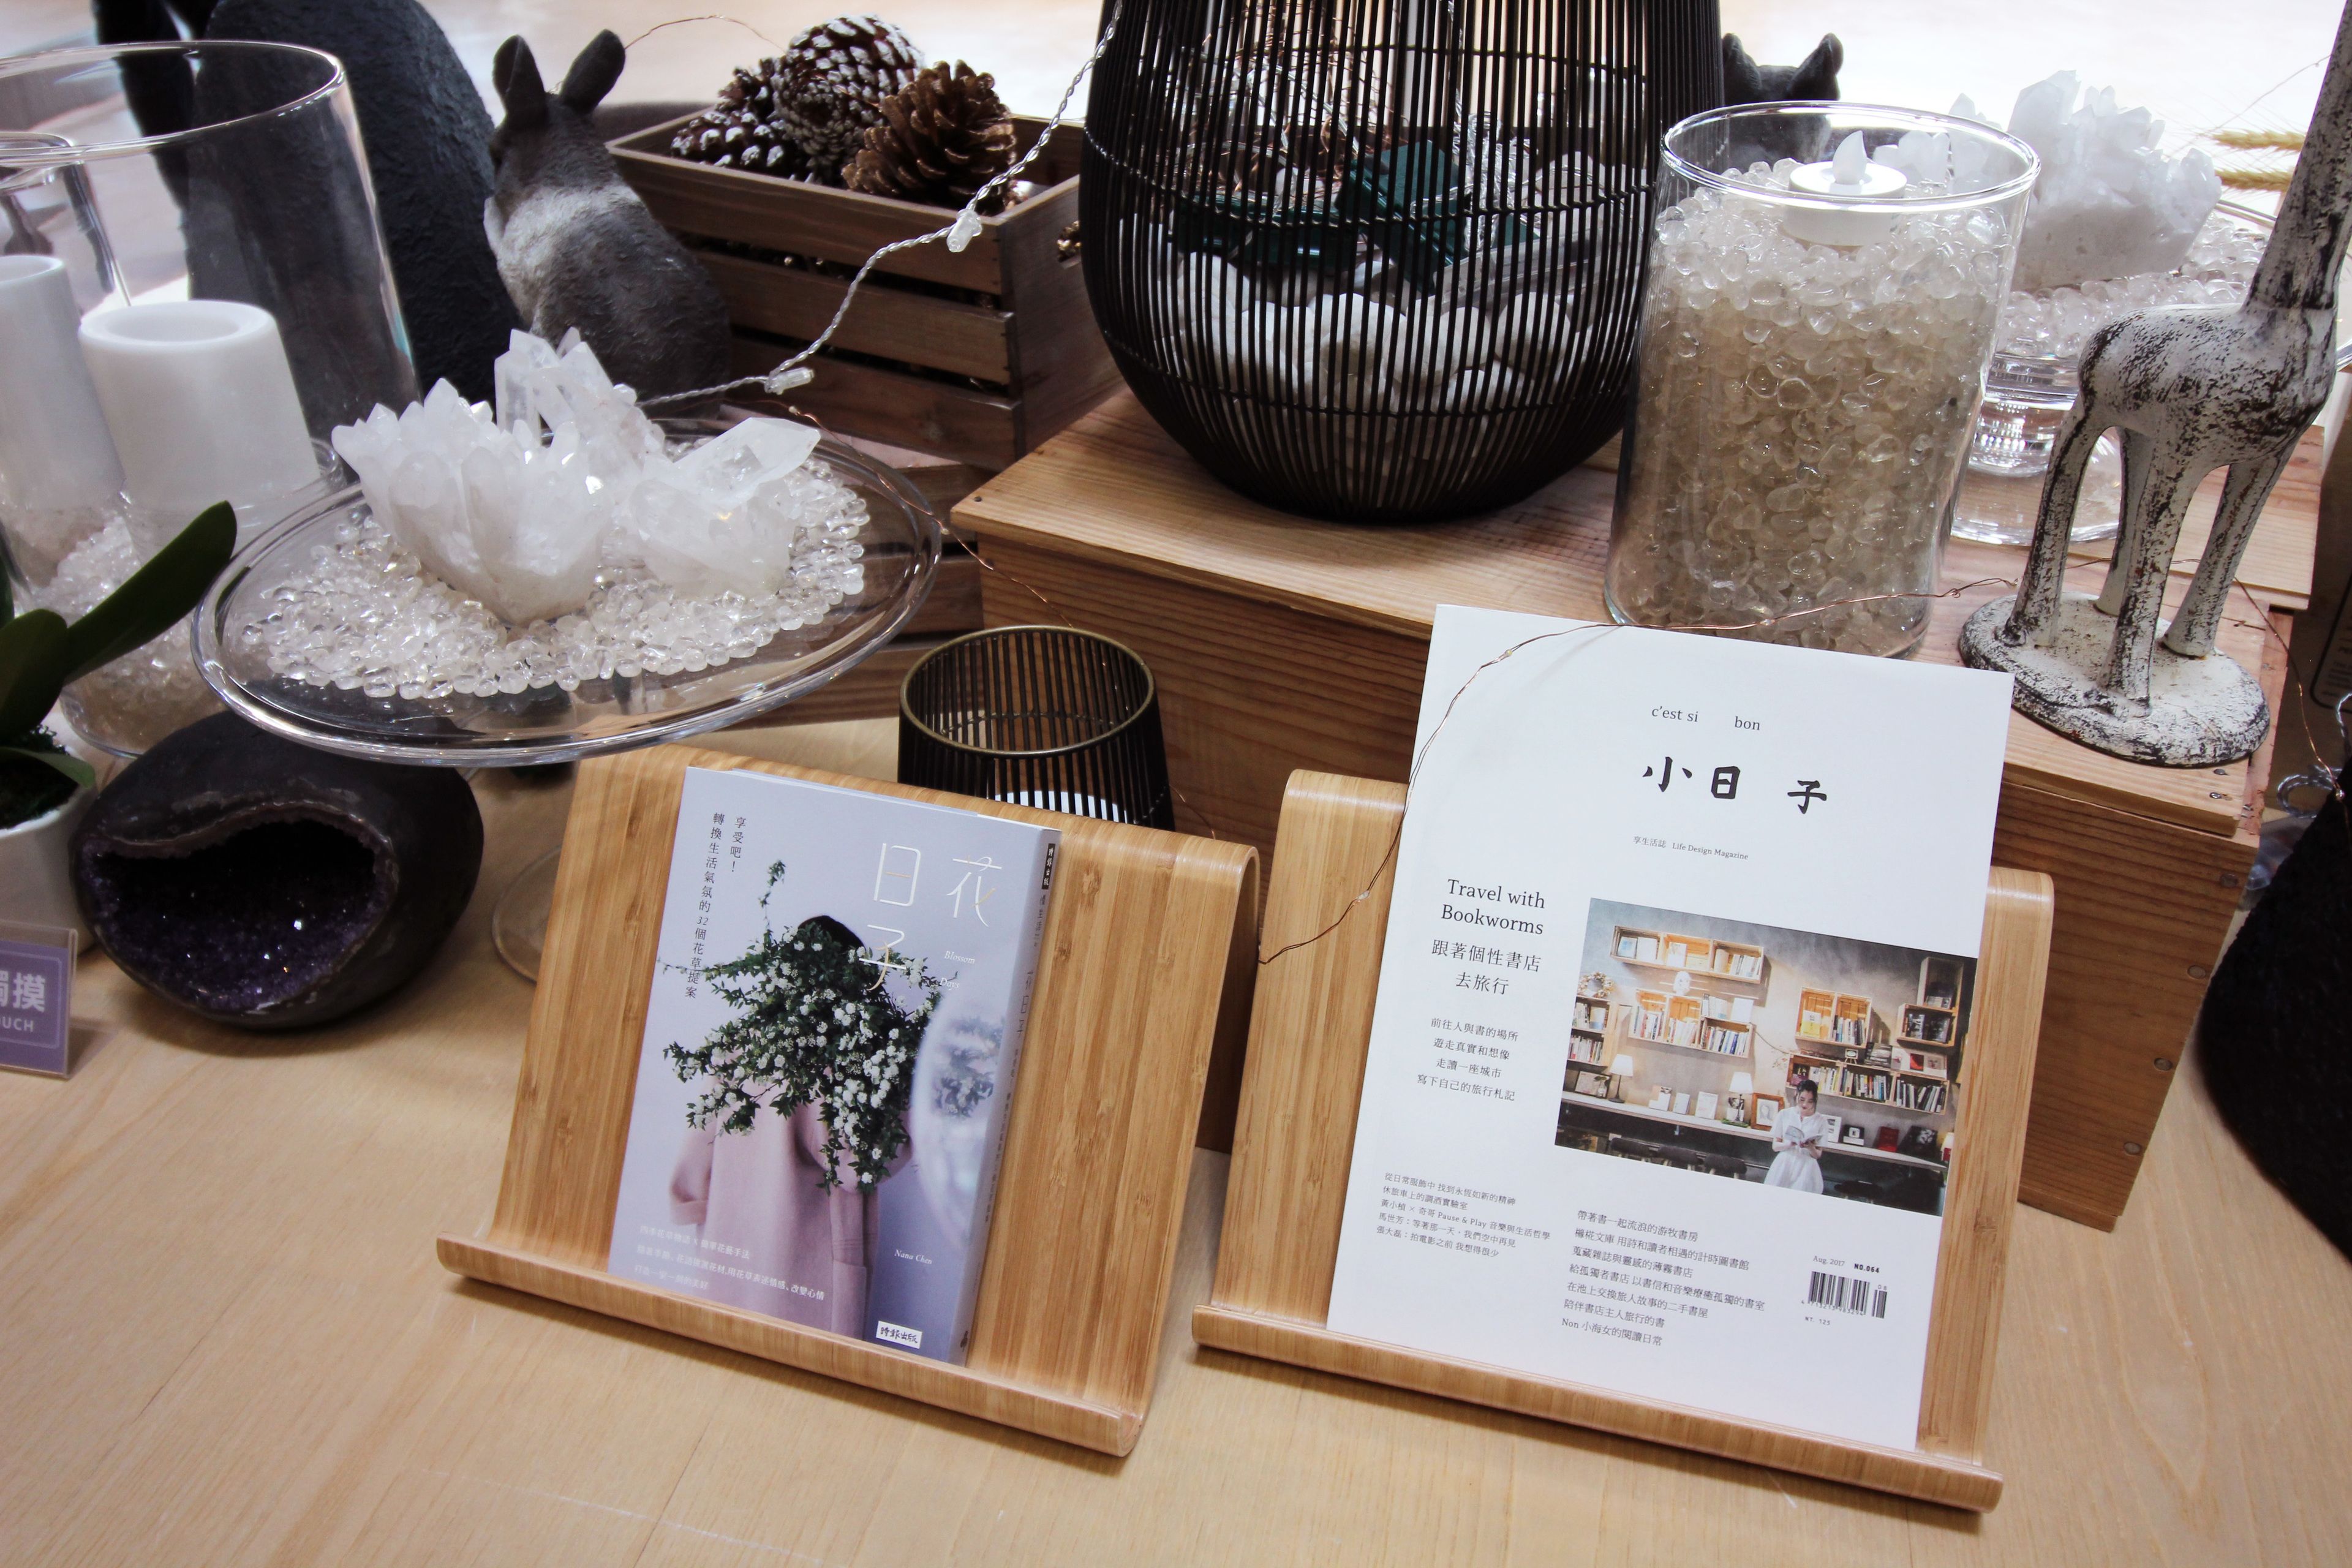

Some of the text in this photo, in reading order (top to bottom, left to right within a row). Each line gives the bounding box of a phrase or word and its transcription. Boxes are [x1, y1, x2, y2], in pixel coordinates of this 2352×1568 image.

[1687, 710, 1699, 723] si
[1733, 715, 1762, 731] bon
[729, 816, 747, 873] 享受吧！
[1672, 840, 1687, 851] Life
[1687, 843, 1713, 856] Design
[1714, 848, 1749, 861] Magazine
[1447, 878, 1546, 910] Travel with
[1441, 903, 1544, 935] Bookworms
[944, 950, 976, 965] Blossom
[1431, 938, 1542, 973] 跟著個性書店
[939, 976, 961, 991] Days
[1455, 971, 1510, 996] 去旅行
[0, 1017, 34, 1033] UCH
[1430, 1017, 1519, 1042] 前往人與書的場所
[1433, 1036, 1511, 1061] 遊走真實和想像
[1435, 1057, 1502, 1079] 走讀一座城市
[1417, 1074, 1516, 1102] 寫下自己的旅行札記
[1438, 1211, 1460, 1223] Pause
[1471, 1218, 1487, 1230] Play
[1577, 1209, 1698, 1243] 帶著書一起流浪的游牧書房
[894, 1249, 933, 1265] Nana Chen
[1830, 1259, 1845, 1267] 2017
[1853, 1263, 1879, 1273] NO.064
[1561, 1317, 1580, 1329] Non
[1563, 1298, 1666, 1329] 陪伴書店主人旅行的書
